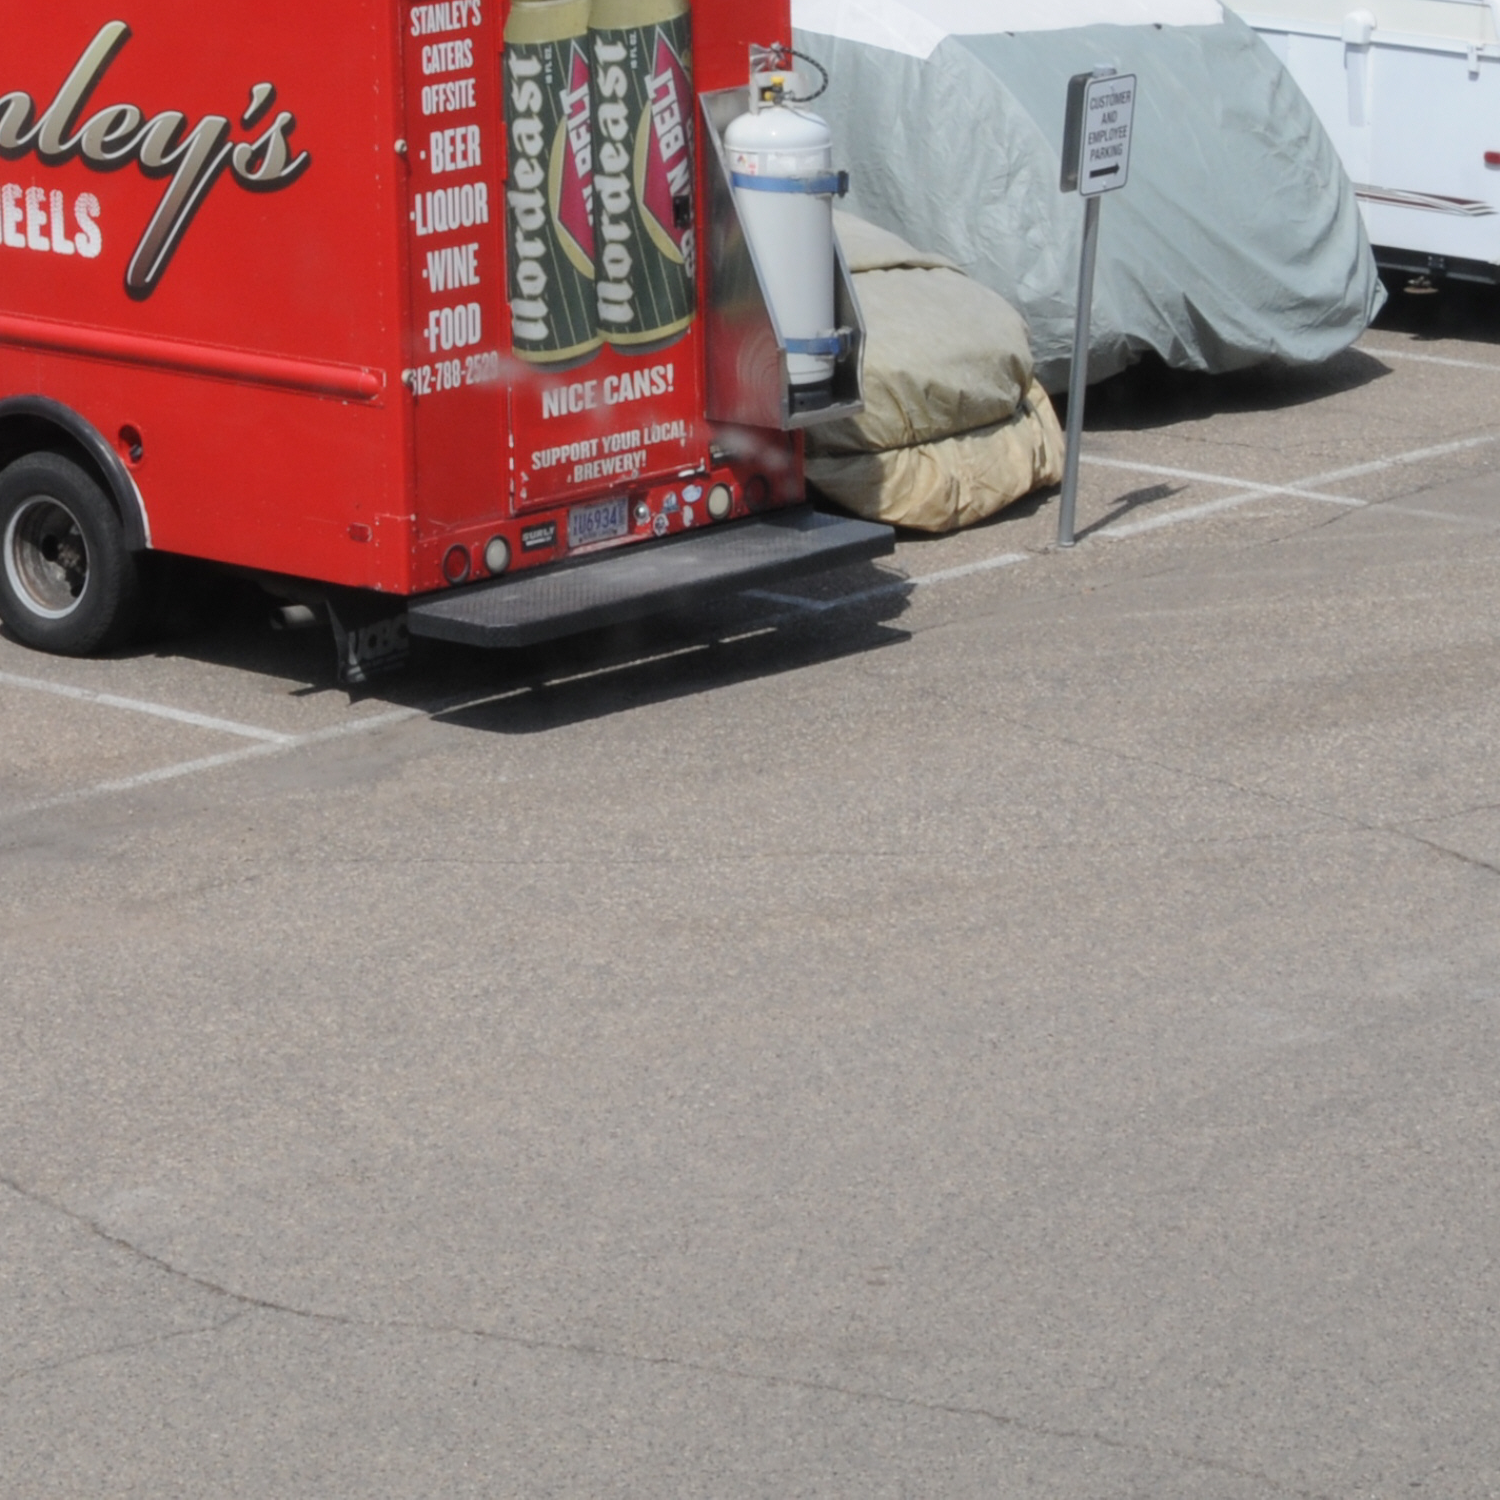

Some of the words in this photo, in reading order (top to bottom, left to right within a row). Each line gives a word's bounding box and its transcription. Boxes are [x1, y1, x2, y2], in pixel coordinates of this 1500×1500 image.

[422, 38, 473, 76] CATERS
[421, 77, 476, 116] OFFSITE
[644, 66, 686, 164] BELT
[1089, 90, 1132, 111] CUSTOMER
[1101, 110, 1118, 125] AND
[430, 124, 482, 175] BEER
[1088, 124, 1128, 146] EMPLOYEE
[1089, 143, 1123, 162] PARKING
[507, 49, 549, 341] Nordeast
[594, 34, 635, 324] Nordeast
[414, 181, 489, 237] LIQUOR
[426, 242, 480, 294] WINE
[428, 301, 482, 353] FOOD
[542, 379, 597, 420] NICE
[603, 363, 674, 406] CANS!
[531, 439, 598, 471] SUPPORT
[602, 427, 641, 455] YOUR
[644, 419, 687, 448] LOCAL
[573, 451, 647, 484] BREWERY!
